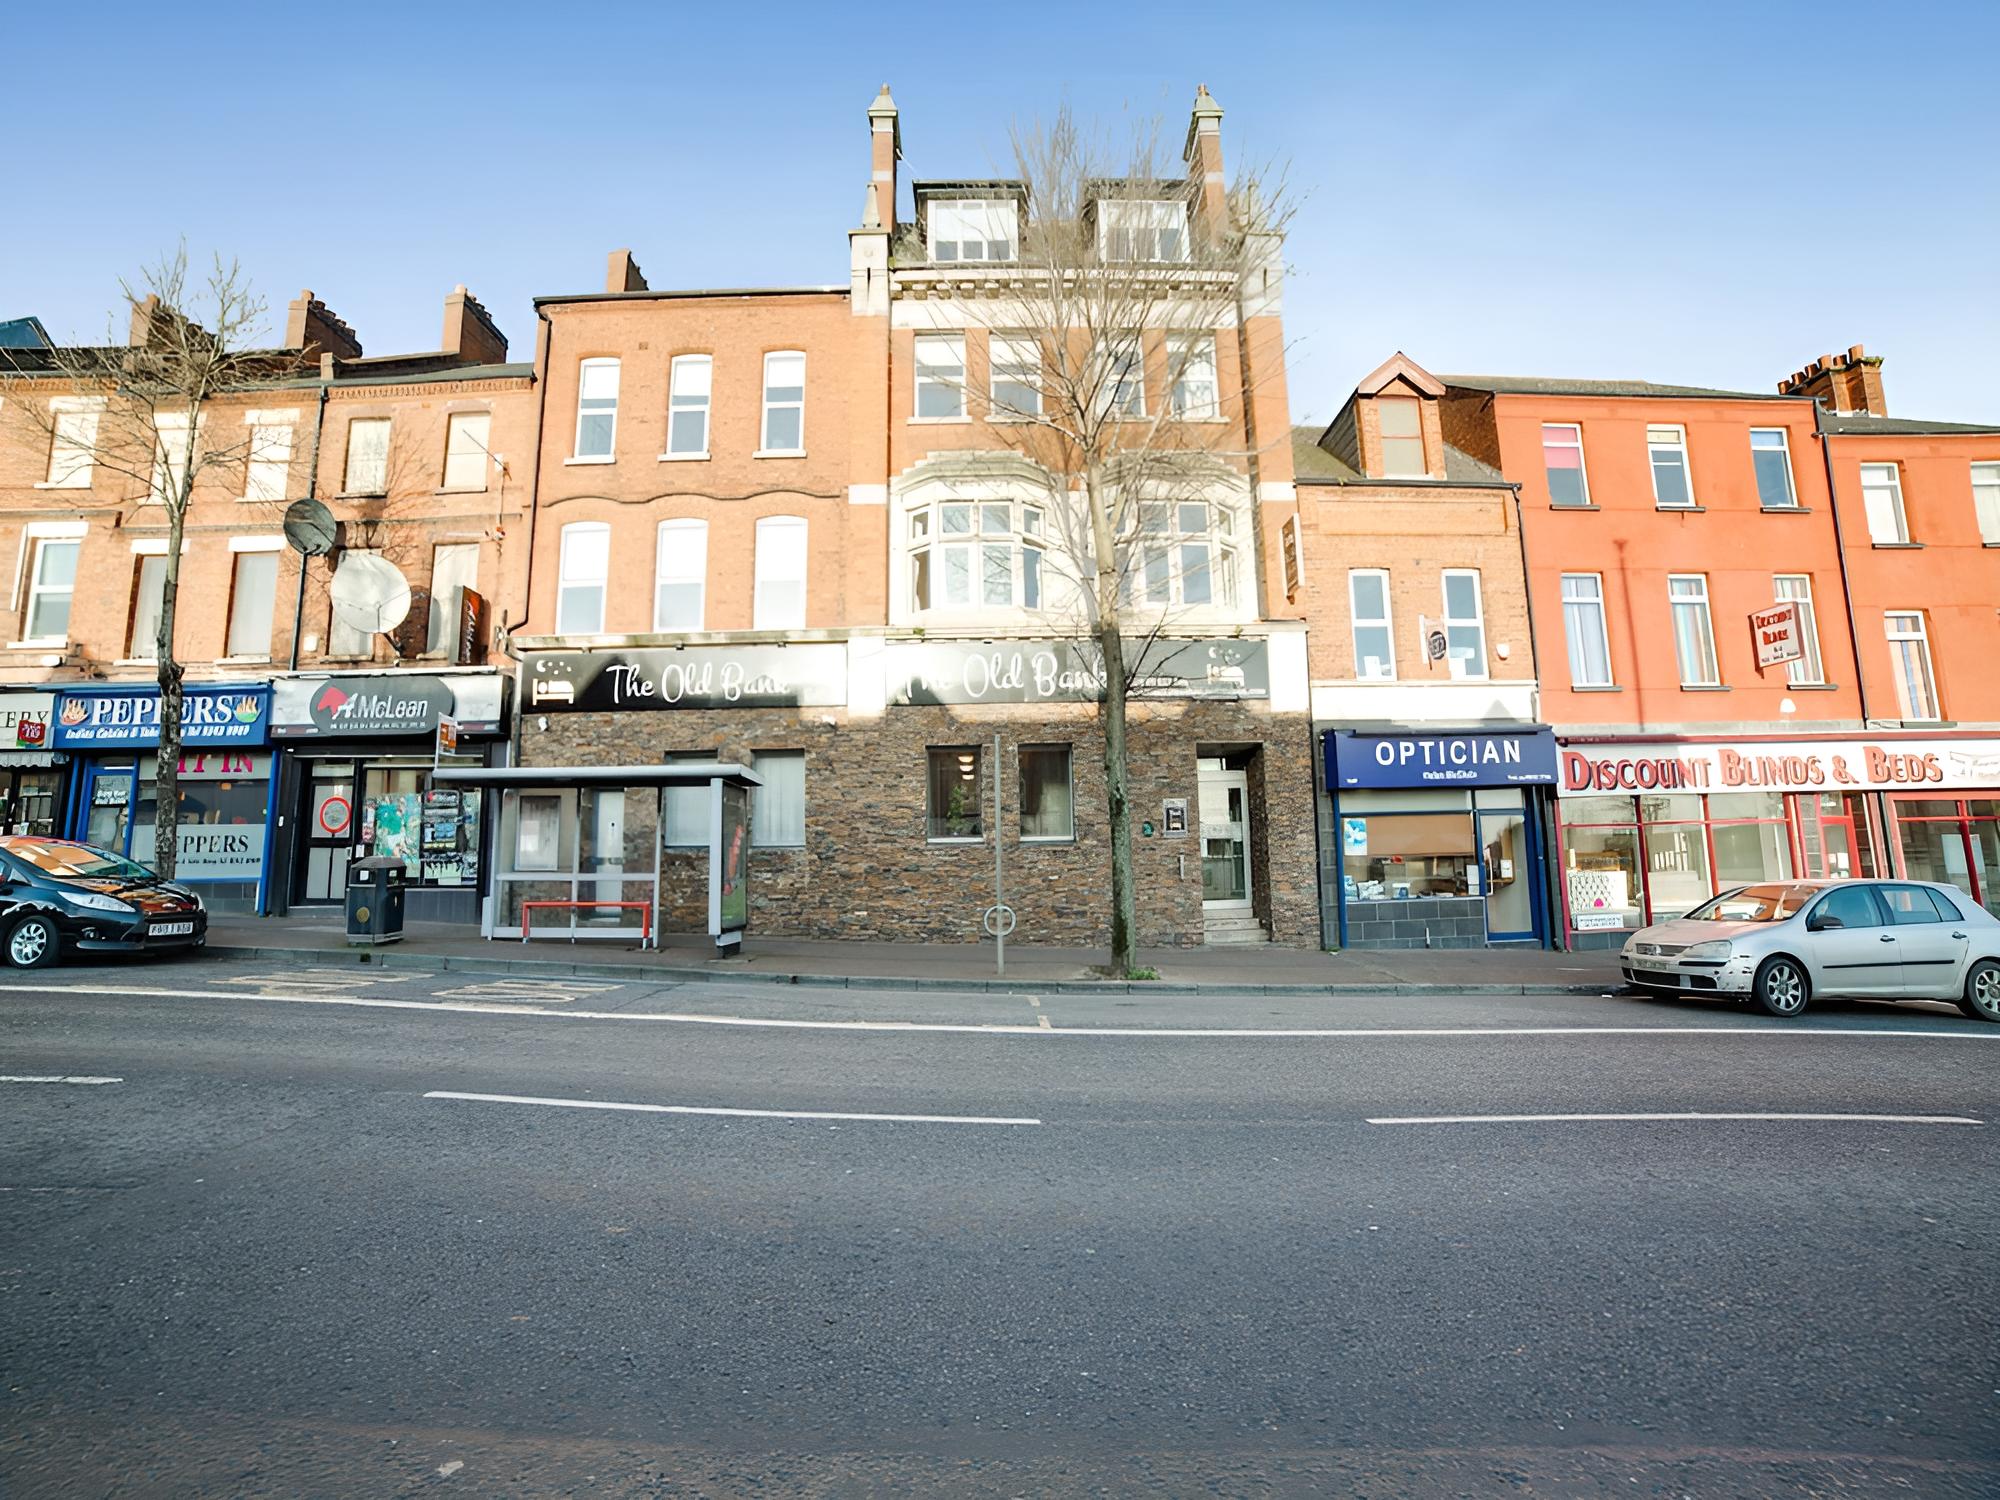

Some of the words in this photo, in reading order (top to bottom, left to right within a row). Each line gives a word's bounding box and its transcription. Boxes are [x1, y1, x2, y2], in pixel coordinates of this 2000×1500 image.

[605, 663, 655, 704] The
[661, 661, 713, 703] Old
[963, 651, 1024, 698] Old
[1032, 651, 1108, 697] Bank
[91, 695, 233, 725] PEPERS
[1375, 740, 1521, 766] OPTICIAN
[1562, 751, 1713, 792] DISCOUNT
[1831, 755, 1860, 785] &
[1863, 745, 1944, 784] BEDS
[176, 834, 249, 854] PPERS
